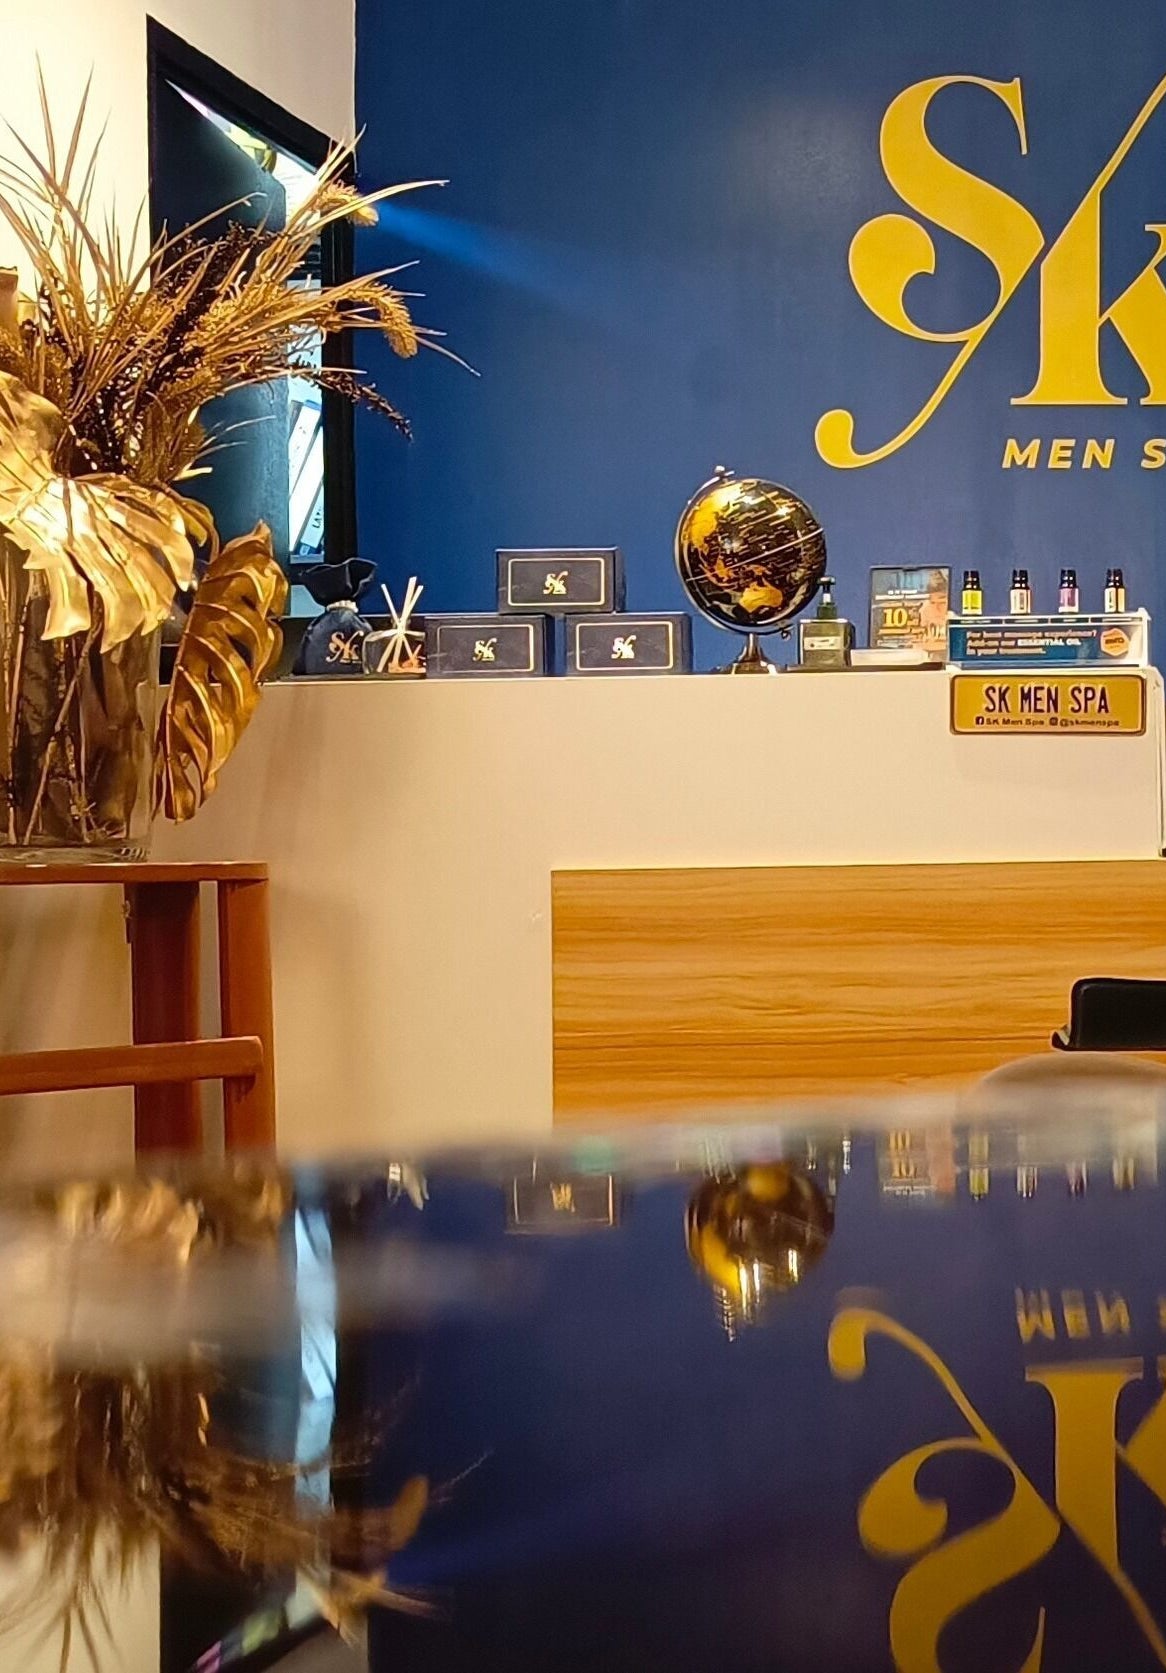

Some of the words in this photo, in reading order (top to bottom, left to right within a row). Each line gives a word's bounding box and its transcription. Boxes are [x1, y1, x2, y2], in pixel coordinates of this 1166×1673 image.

[1002, 438, 1115, 469] MEN
[984, 685, 1011, 713] SK
[1020, 685, 1059, 713] MEN
[1070, 685, 1110, 713] SPA
[1002, 718, 1023, 726] Men
